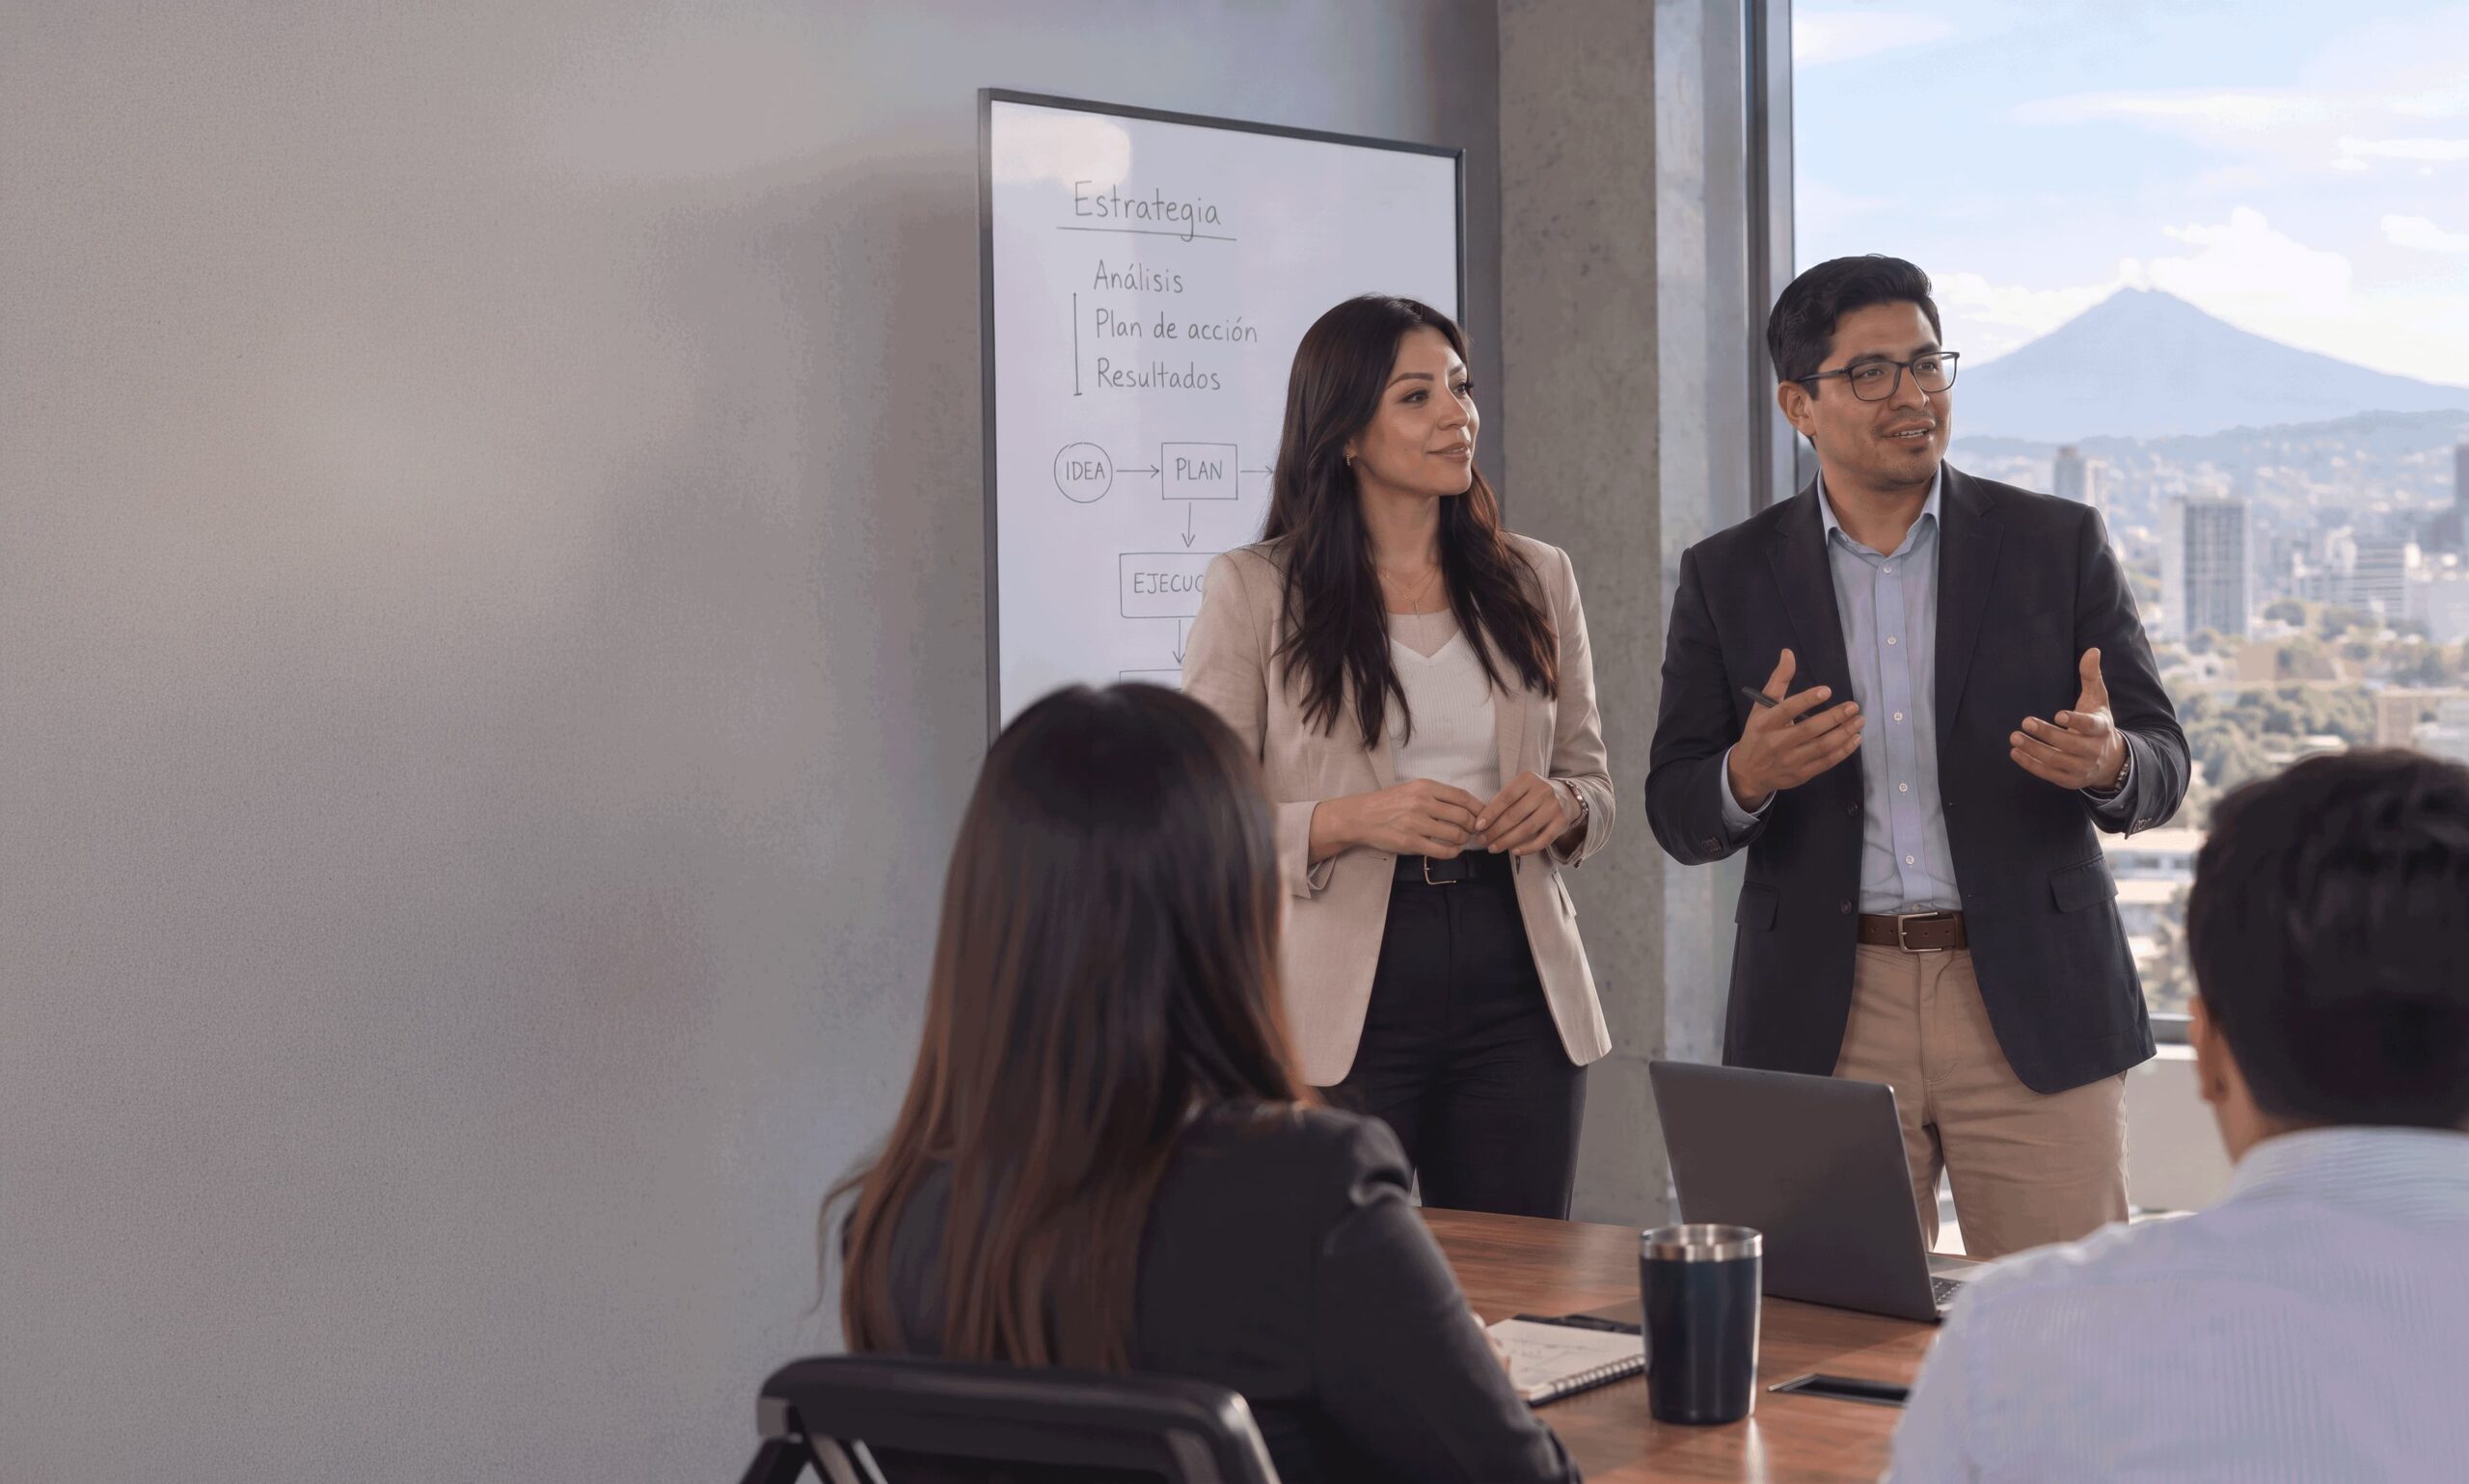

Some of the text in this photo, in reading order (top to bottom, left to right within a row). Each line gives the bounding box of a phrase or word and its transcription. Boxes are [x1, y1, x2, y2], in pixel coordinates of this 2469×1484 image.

[1073, 180, 1221, 242] Estrategia
[1094, 259, 1184, 293] Análisis
[1097, 309, 1258, 343] Plan de acción
[1098, 358, 1221, 391] Resultados
[1065, 461, 1106, 481] IDEA
[1176, 457, 1223, 481] PLAN
